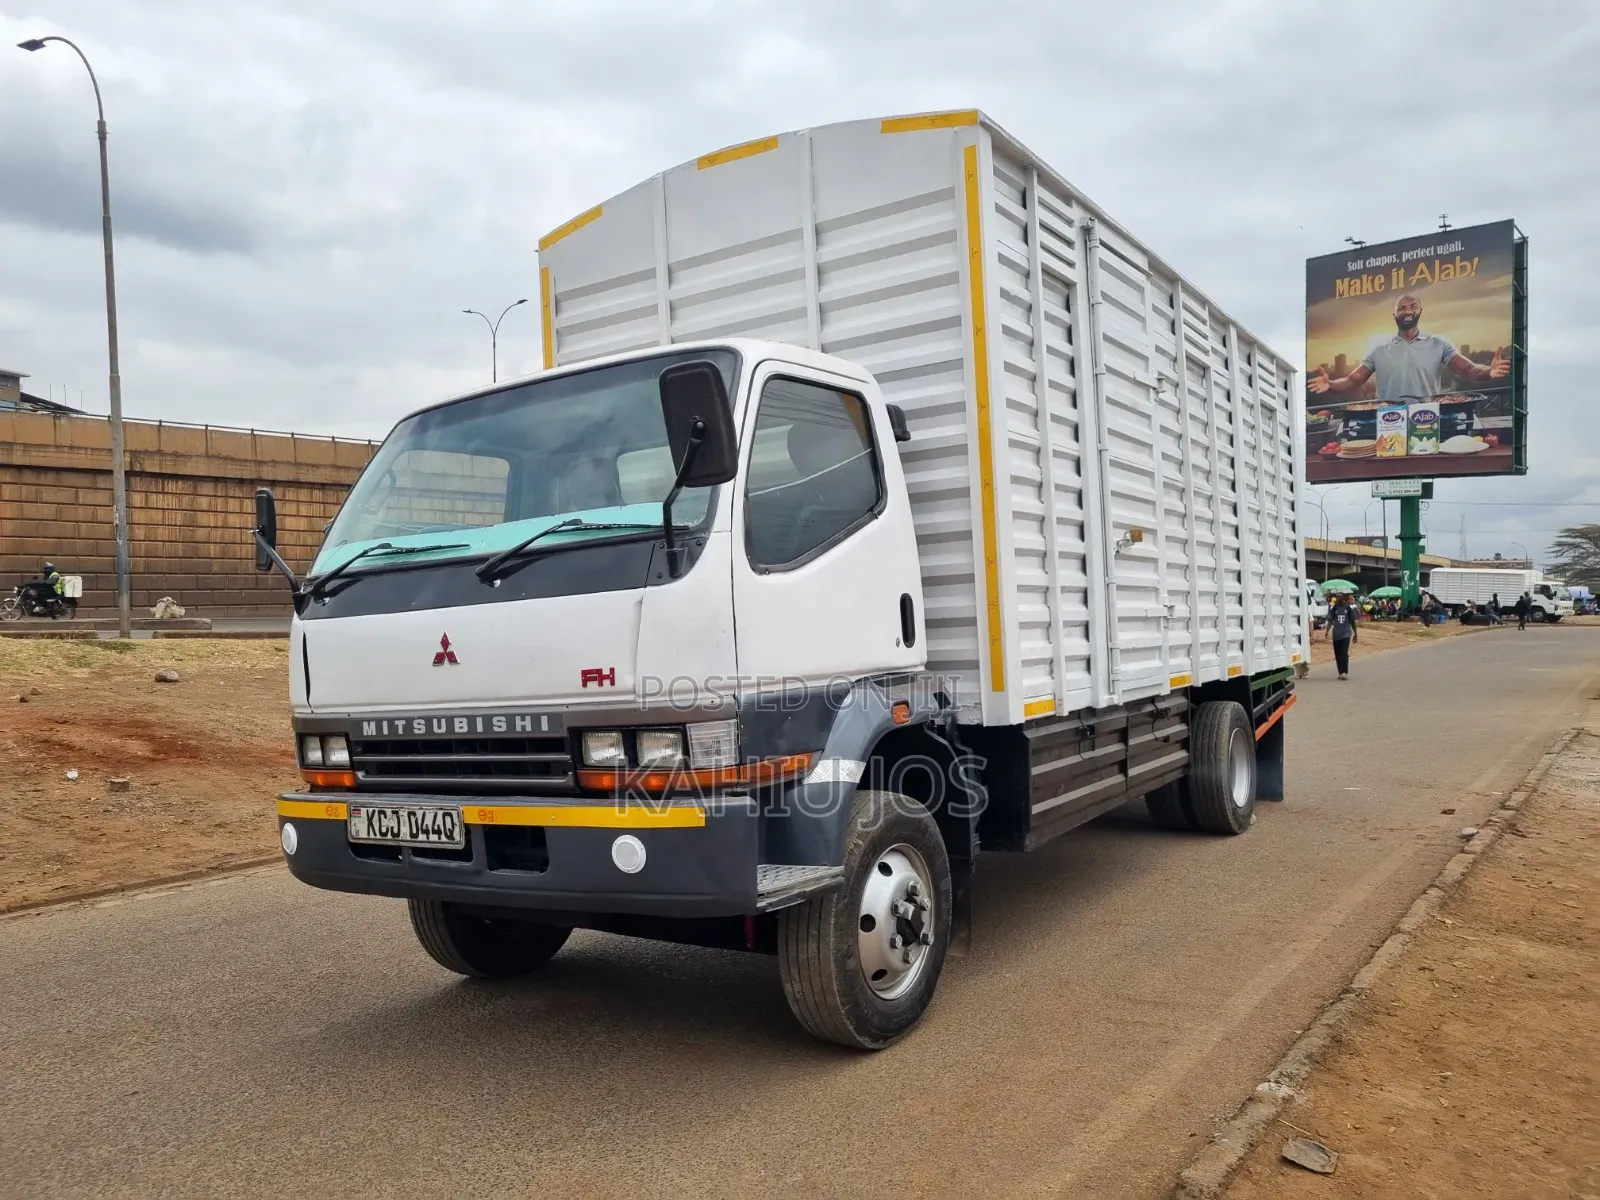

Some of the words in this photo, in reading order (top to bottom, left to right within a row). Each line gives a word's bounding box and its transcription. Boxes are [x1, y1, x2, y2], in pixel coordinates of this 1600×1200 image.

[1366, 254, 1400, 268] chapos,
[1402, 245, 1435, 262] perfect
[1437, 240, 1465, 255] ugali.
[1335, 273, 1385, 299] Make
[1391, 267, 1405, 290] it
[580, 667, 616, 688] FH
[362, 715, 549, 736] MITSUBISHI
[365, 808, 401, 839] KCJ
